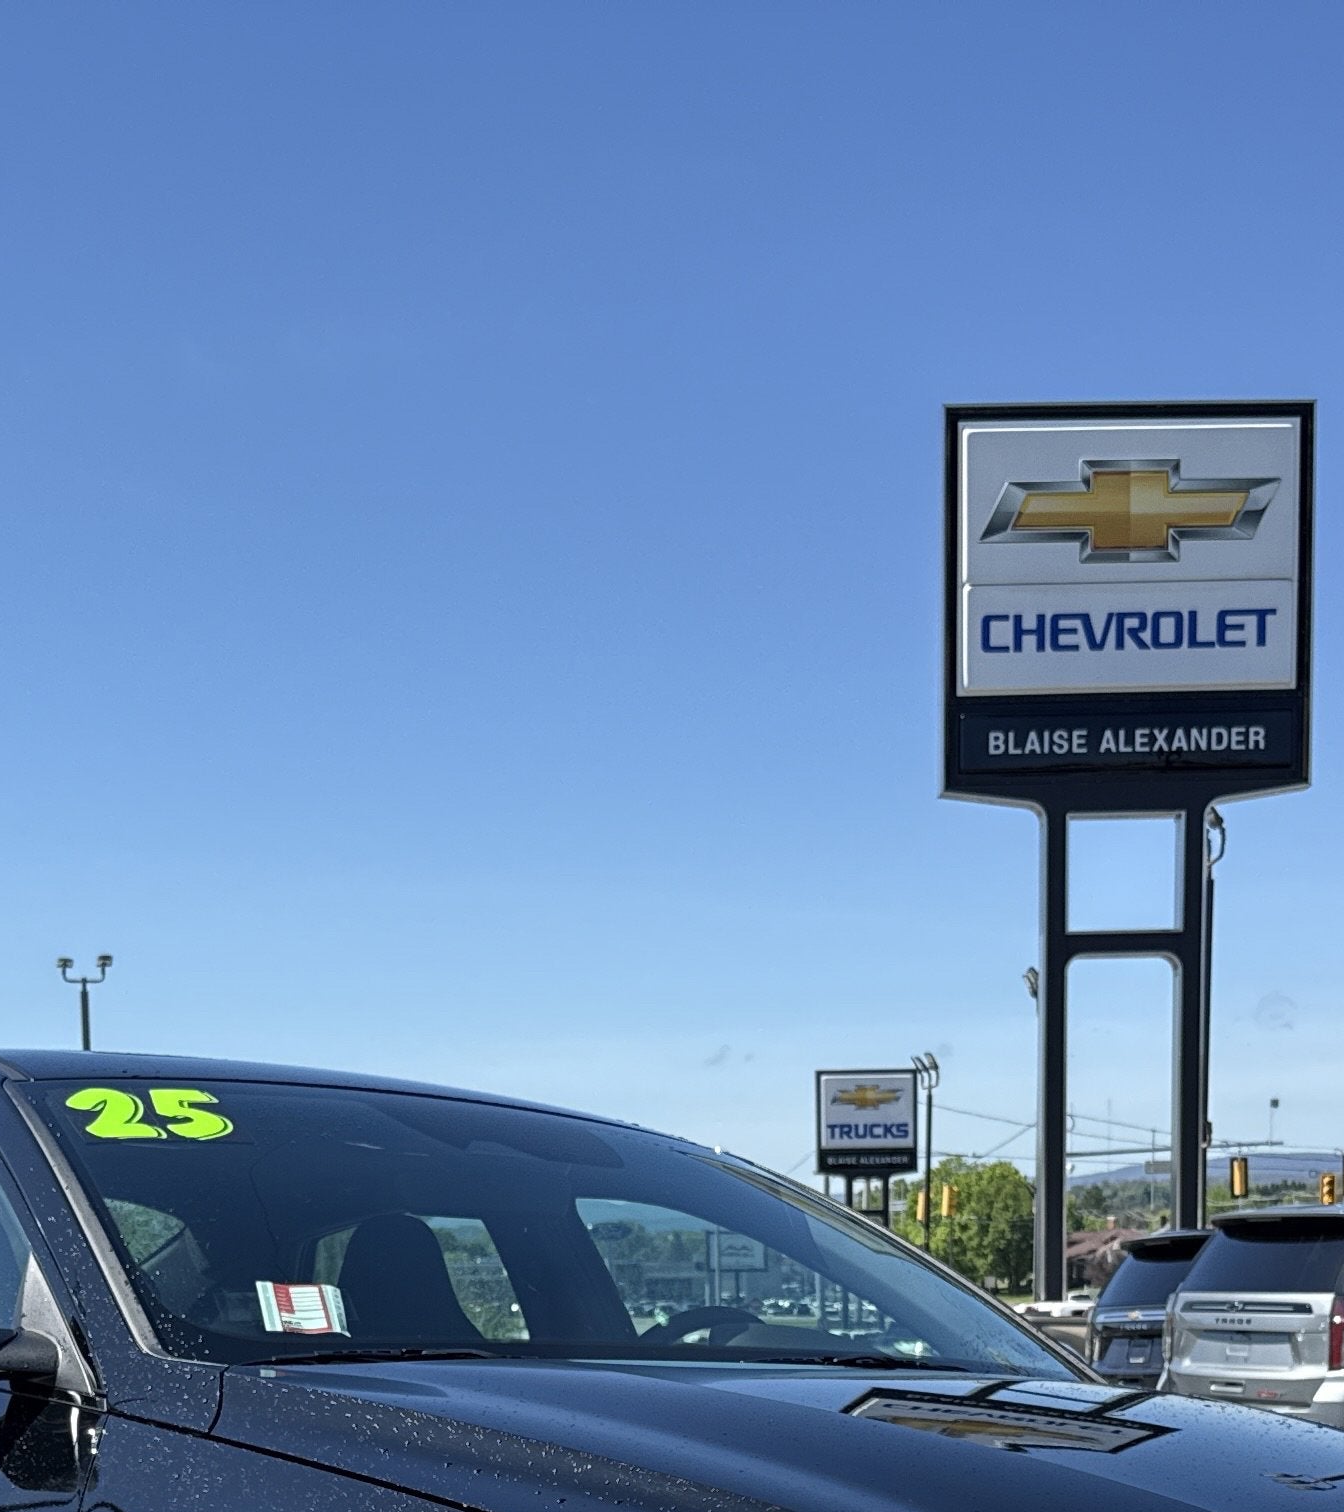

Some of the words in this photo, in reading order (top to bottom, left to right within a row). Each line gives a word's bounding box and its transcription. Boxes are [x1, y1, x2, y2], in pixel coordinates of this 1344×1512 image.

[981, 608, 1277, 653] CHEVROLET
[988, 729, 1088, 755] BLAISE
[1099, 727, 1266, 753] ALEXANDER
[65, 1087, 234, 1141] 25
[826, 1123, 909, 1140] TRUCKS
